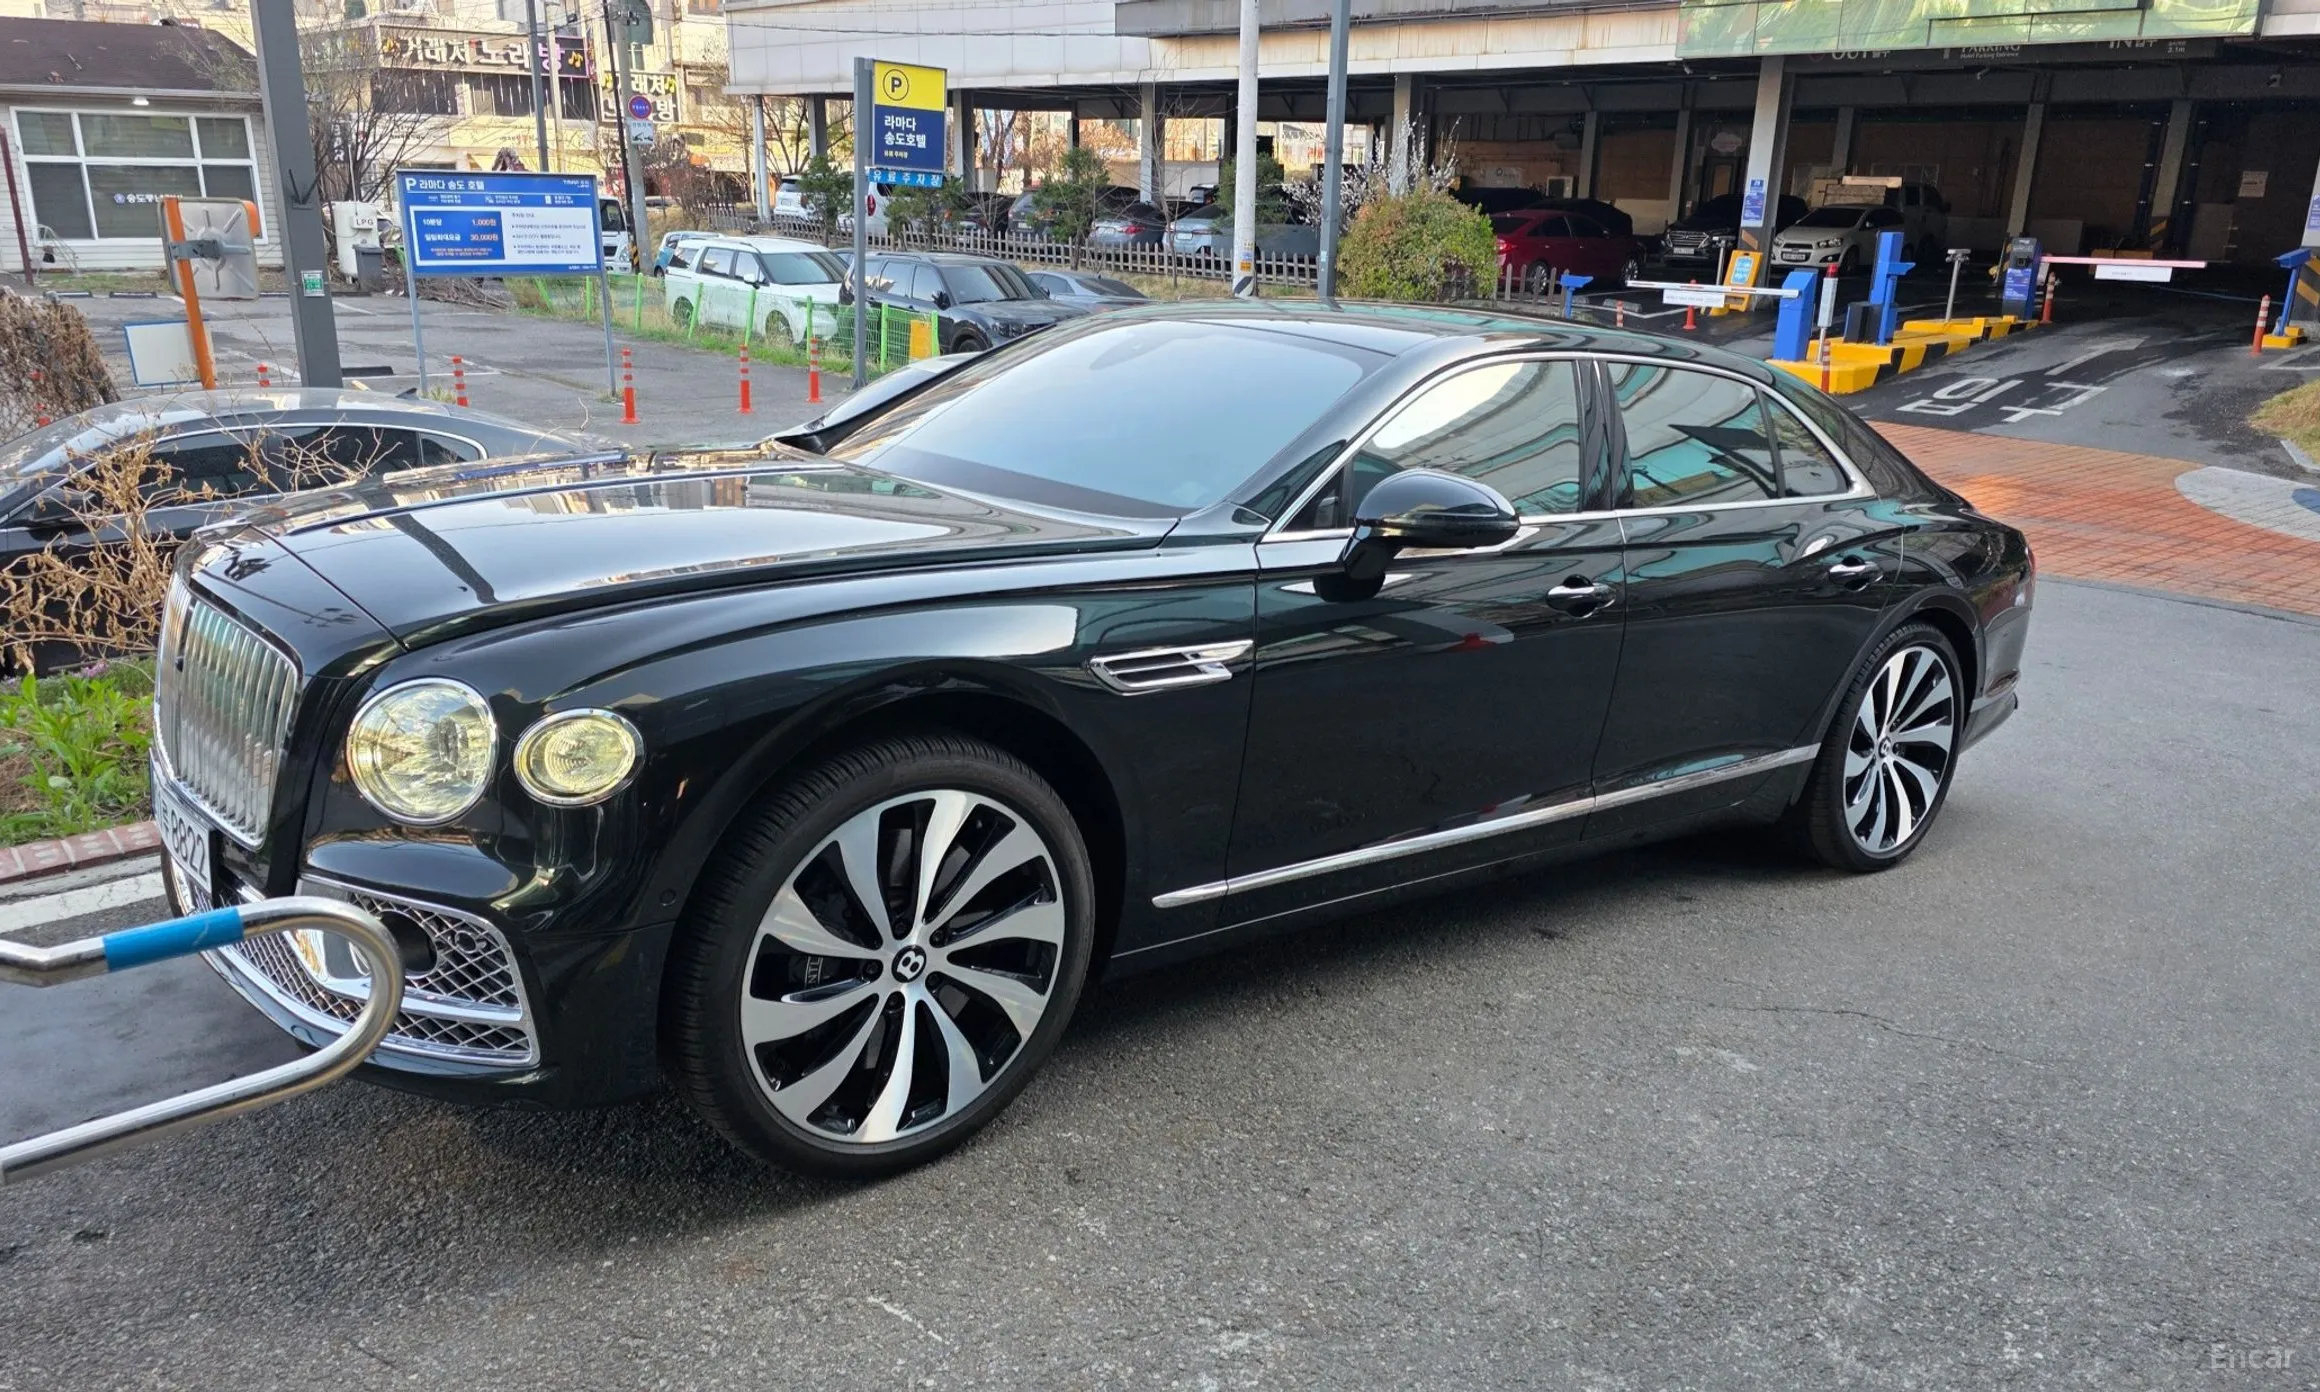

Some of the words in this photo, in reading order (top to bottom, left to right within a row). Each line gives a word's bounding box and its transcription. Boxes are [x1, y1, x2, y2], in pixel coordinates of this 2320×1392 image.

[400, 37, 471, 64] 거래처
[884, 115, 917, 131] 라마다
[884, 132, 926, 149] 송도호텔
[419, 180, 446, 190] 라마다
[447, 181, 465, 190] 송도
[356, 218, 374, 226] LPG
[1896, 378, 2108, 423] 입구
[171, 809, 208, 882] 8822
